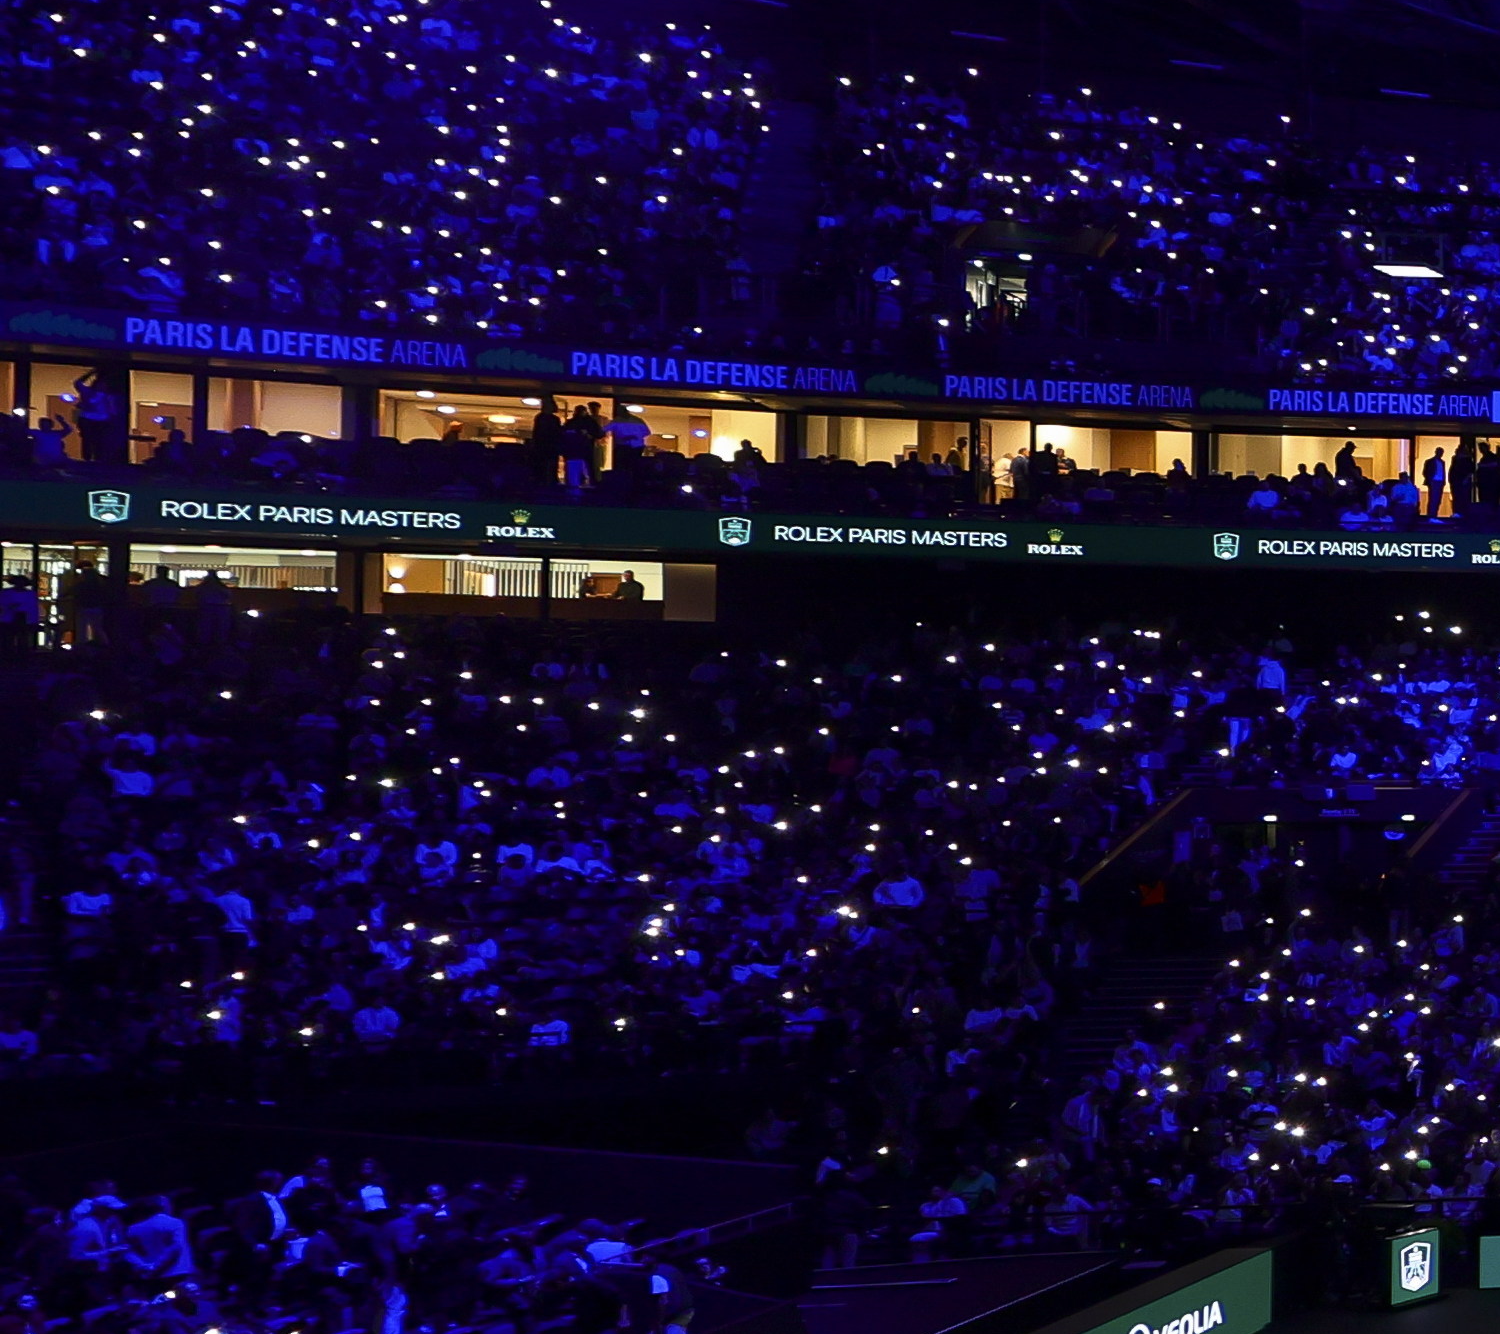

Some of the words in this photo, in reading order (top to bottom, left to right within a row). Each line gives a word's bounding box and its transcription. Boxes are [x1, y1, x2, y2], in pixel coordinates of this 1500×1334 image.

[126, 317, 213, 349] PARIS
[220, 325, 254, 352] LA
[261, 329, 383, 362] DEFENSE
[390, 340, 466, 367] ARENA
[572, 352, 645, 379] PARIS
[651, 357, 679, 381] LA
[686, 360, 787, 388] DEFENSE
[793, 367, 856, 392] ARENA
[945, 375, 1007, 399] PARIS
[1012, 378, 1037, 401] LA
[1042, 380, 1132, 405] DEFENSE
[1137, 385, 1193, 408] ARENA
[1269, 389, 1323, 411] PARIS
[1328, 391, 1349, 412] LA
[1354, 392, 1434, 415] DEFENSE
[1437, 396, 1489, 418] ARENA
[161, 500, 252, 520] ROLEX
[259, 505, 334, 524] PARIS
[340, 509, 461, 529] MASTERS
[485, 525, 555, 538] ROLEX
[774, 525, 843, 542] ROLEX
[848, 528, 906, 544] PARIS
[911, 530, 1007, 547] MASTERS
[1027, 543, 1083, 555] ROLEX
[1258, 539, 1316, 555] ROLEX
[1319, 541, 1369, 556] PARIS
[1372, 542, 1455, 558] MASTERS
